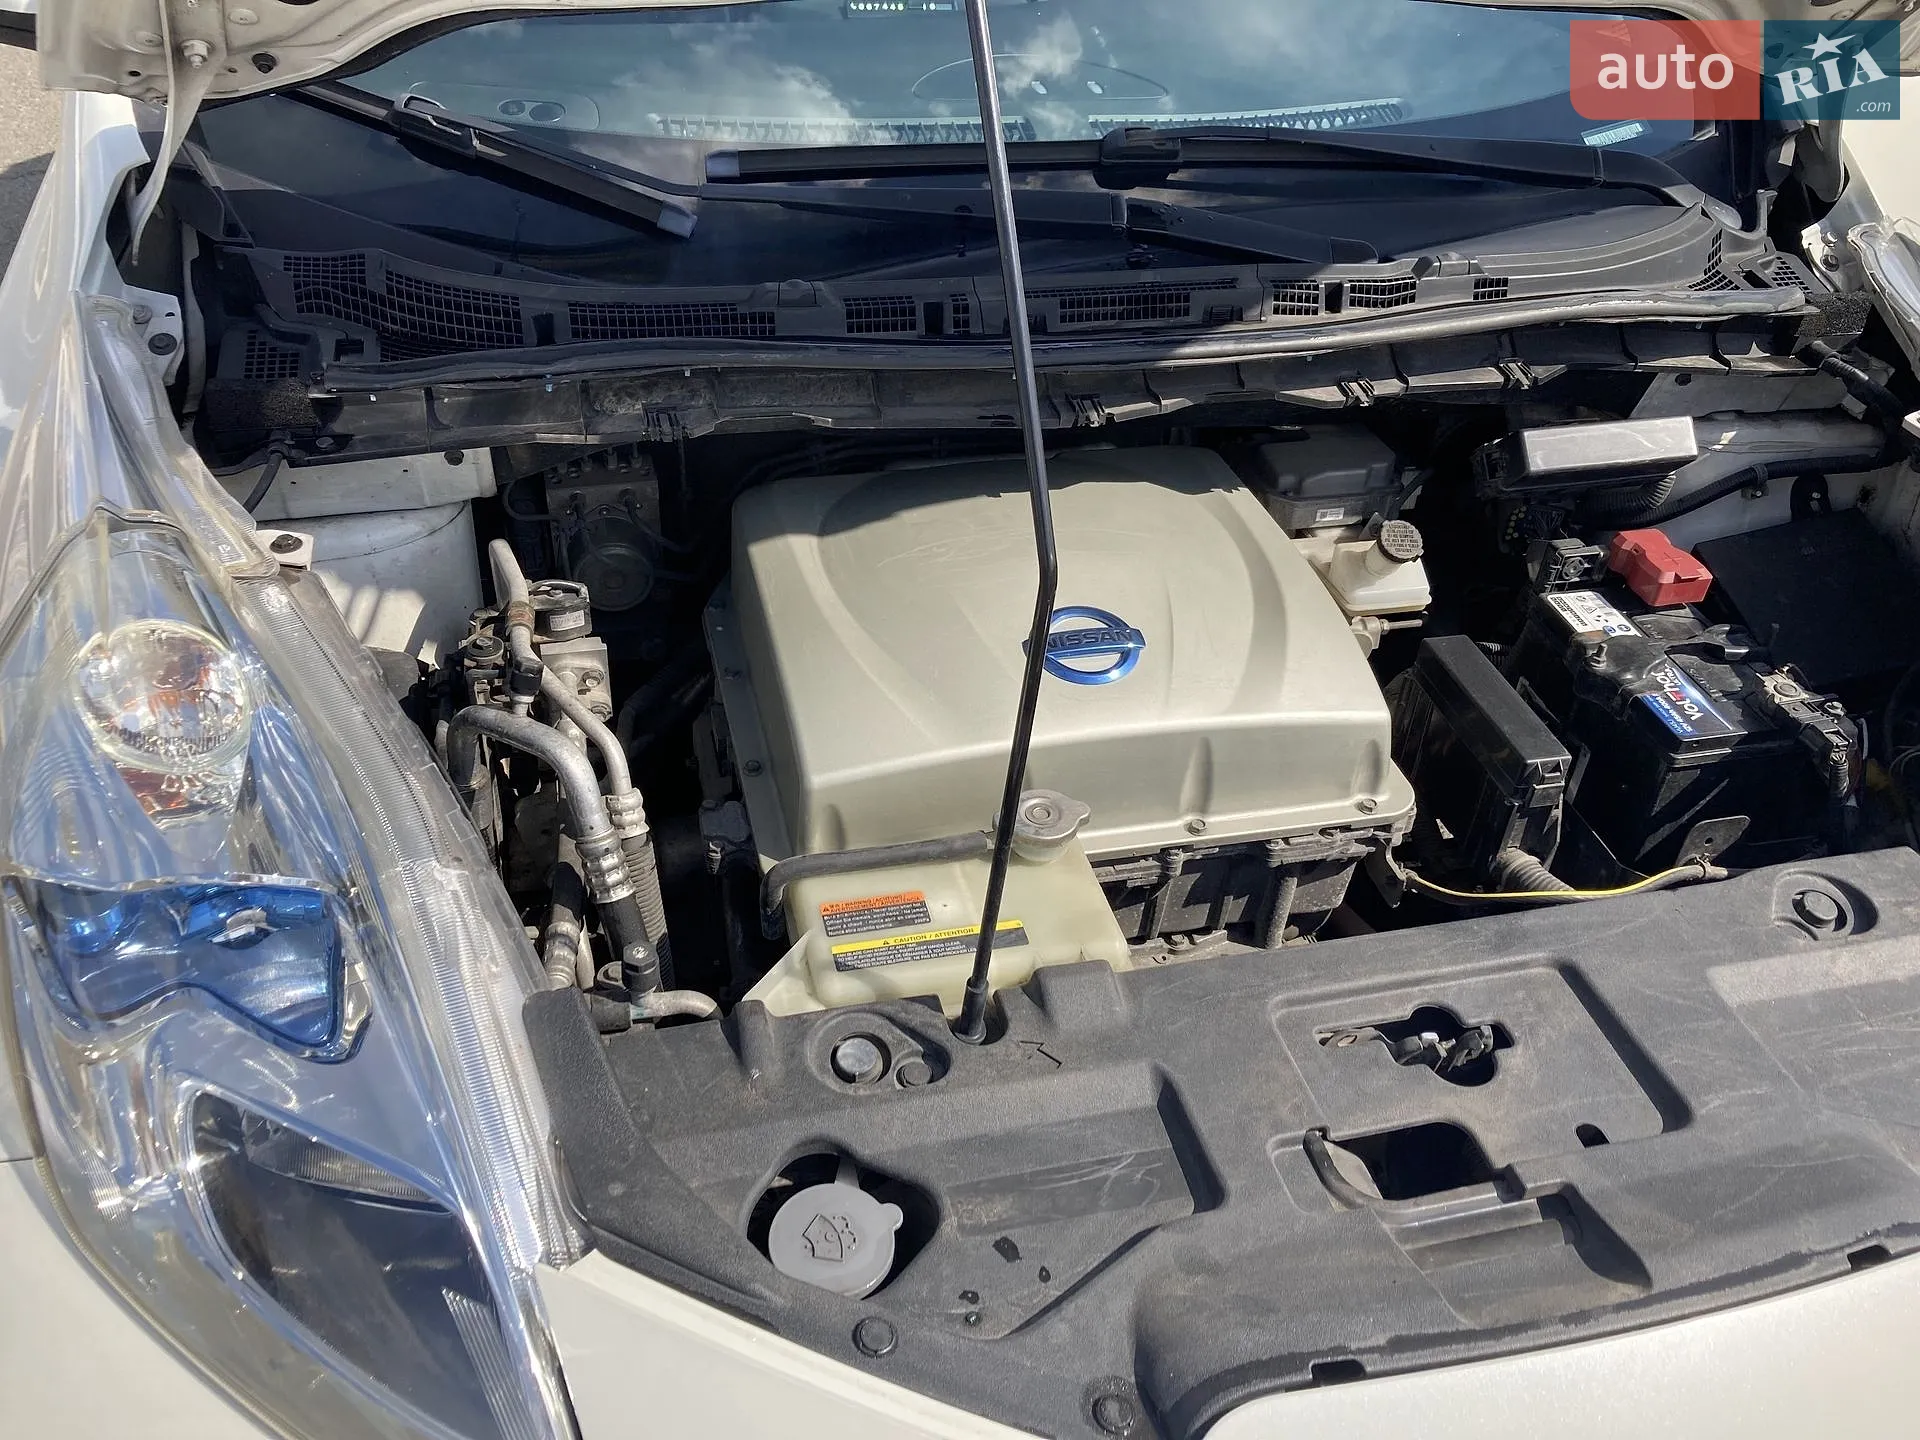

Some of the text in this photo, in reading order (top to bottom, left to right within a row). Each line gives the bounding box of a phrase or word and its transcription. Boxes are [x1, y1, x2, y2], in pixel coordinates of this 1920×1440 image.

[1047, 628, 1133, 649] NISSAN
[894, 935, 927, 944] CAUTION
[934, 928, 974, 938] ATTENTION
